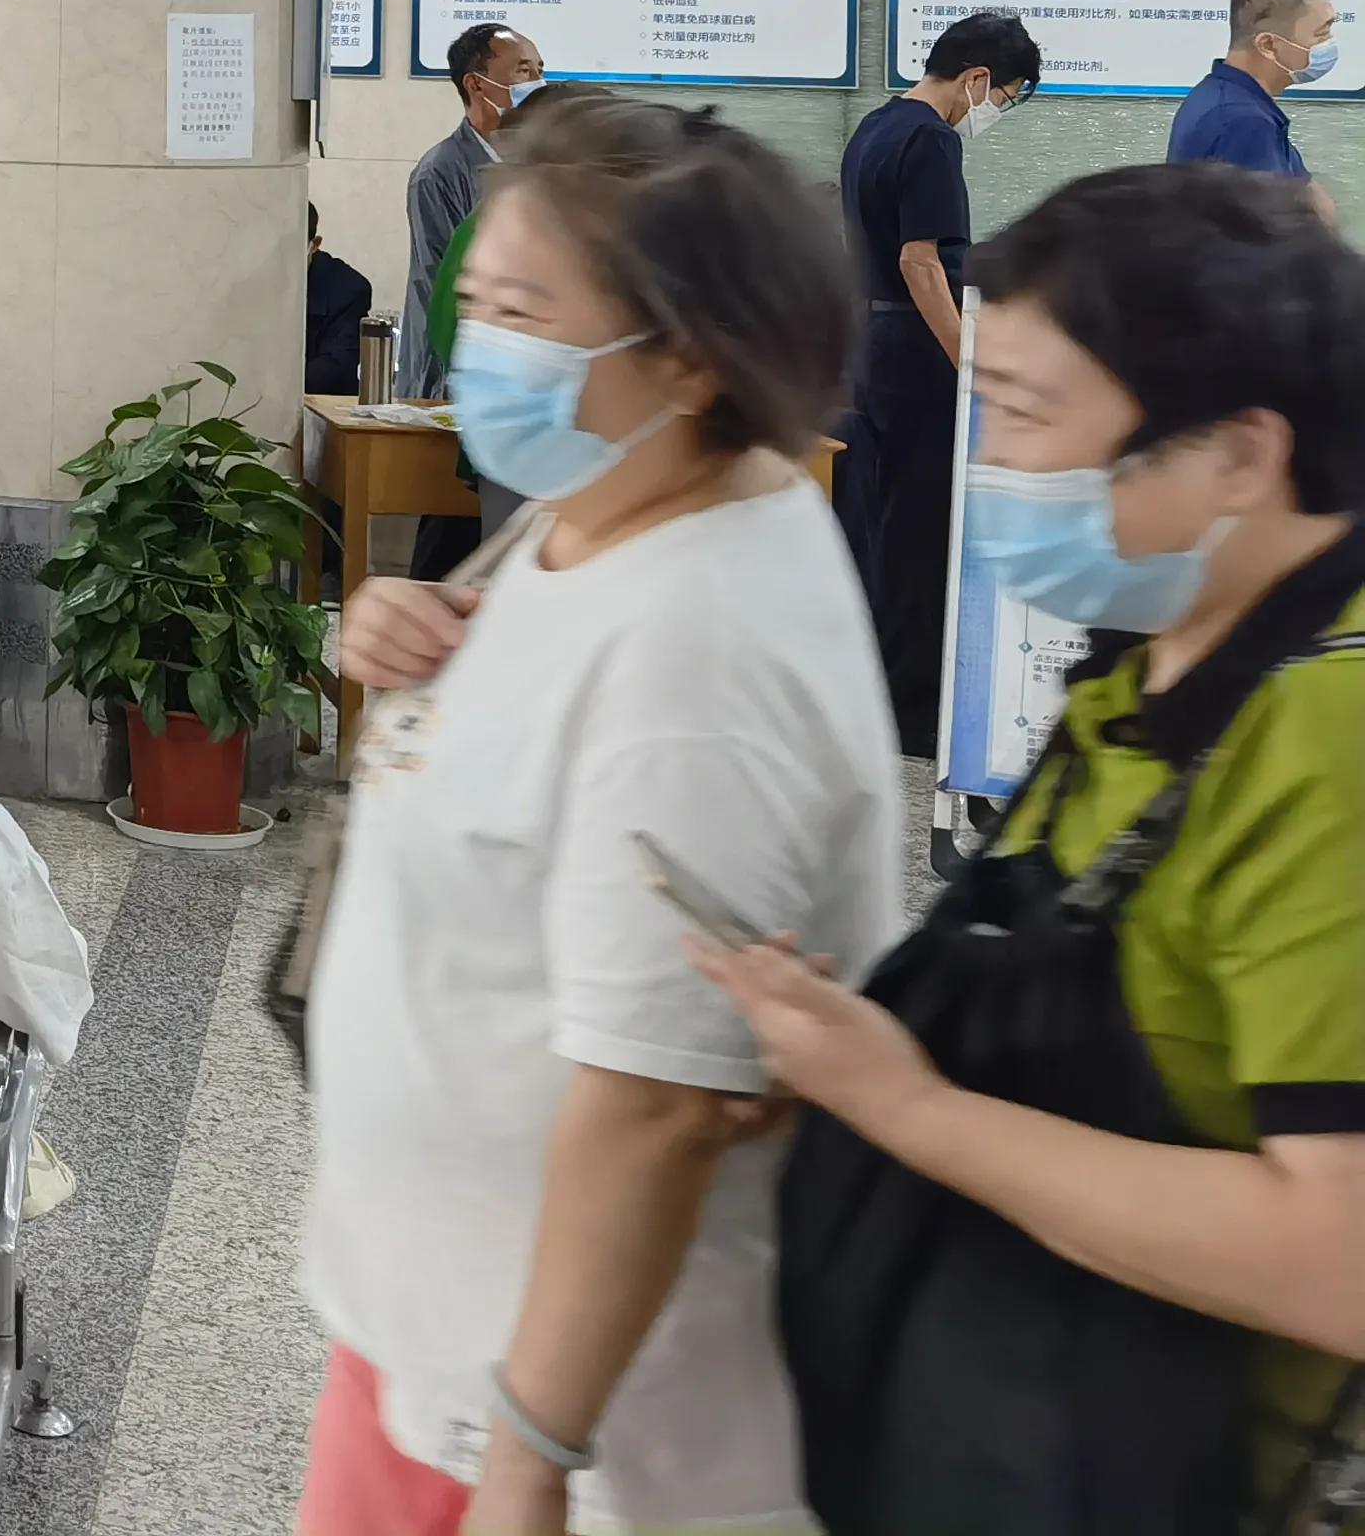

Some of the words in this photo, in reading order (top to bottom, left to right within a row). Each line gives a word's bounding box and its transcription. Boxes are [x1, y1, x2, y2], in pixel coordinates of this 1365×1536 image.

[652, 49, 709, 60] 不完全水化
